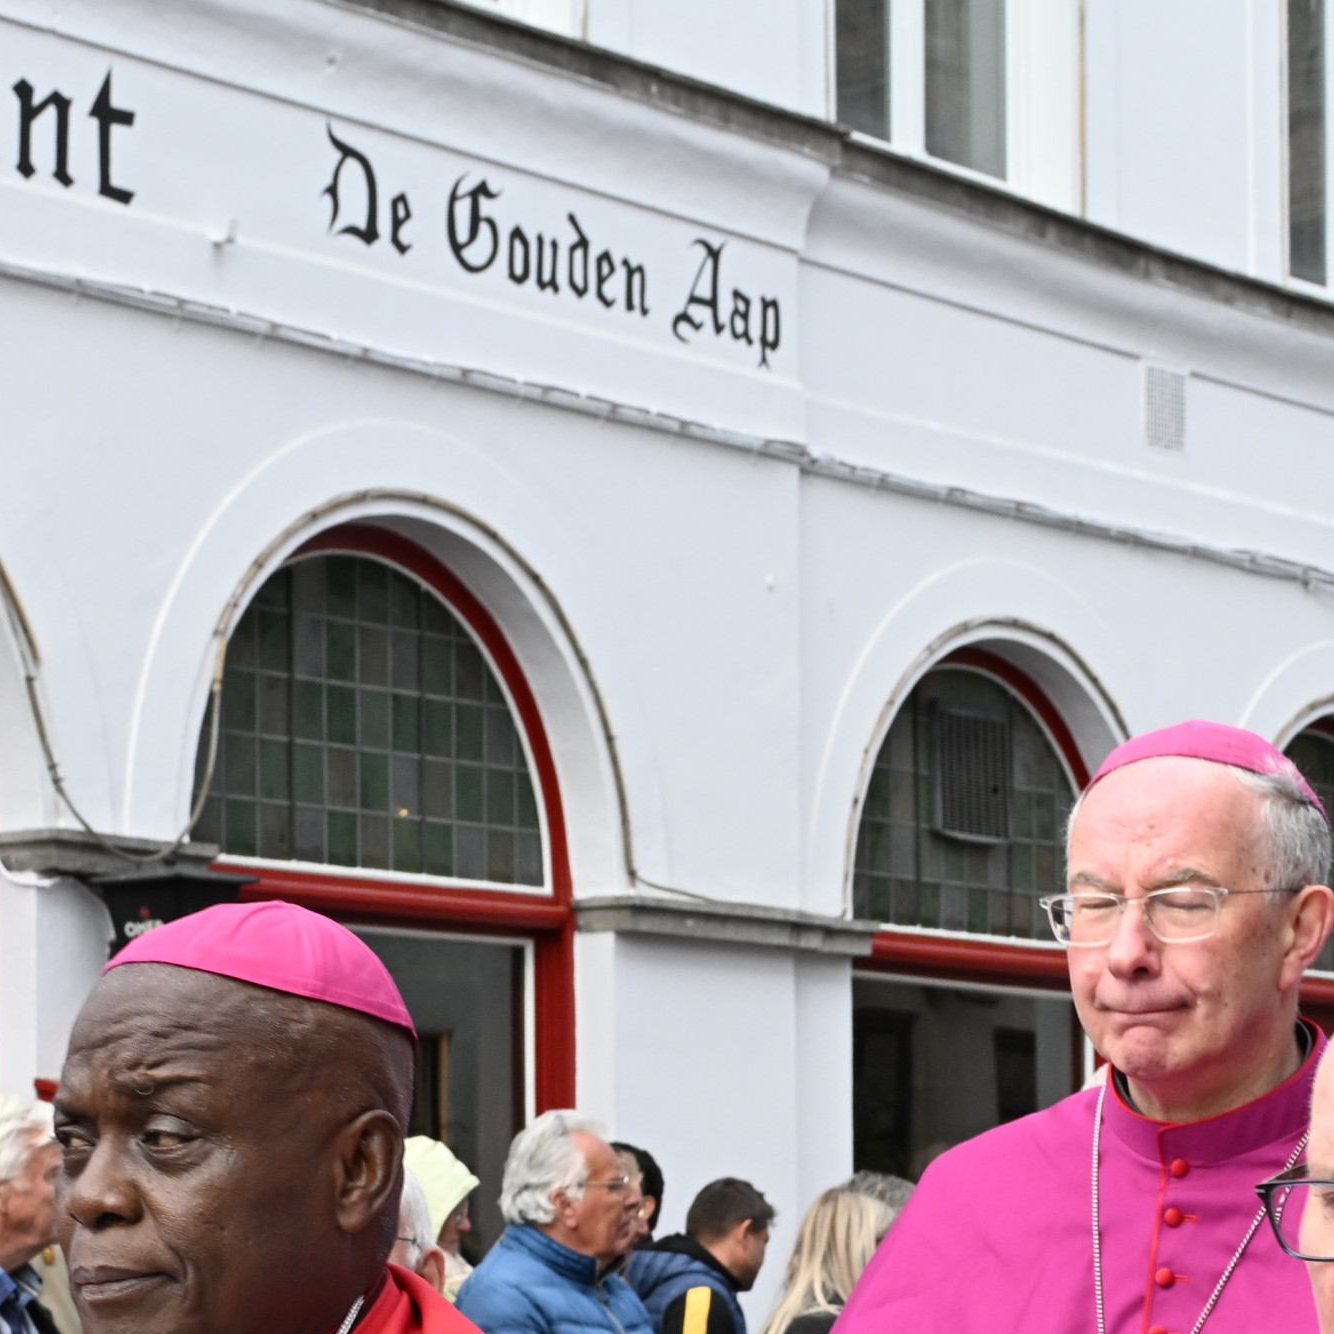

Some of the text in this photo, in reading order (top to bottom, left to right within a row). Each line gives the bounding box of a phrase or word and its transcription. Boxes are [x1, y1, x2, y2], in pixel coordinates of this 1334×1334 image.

[322, 121, 781, 368] De Gouden Aap
